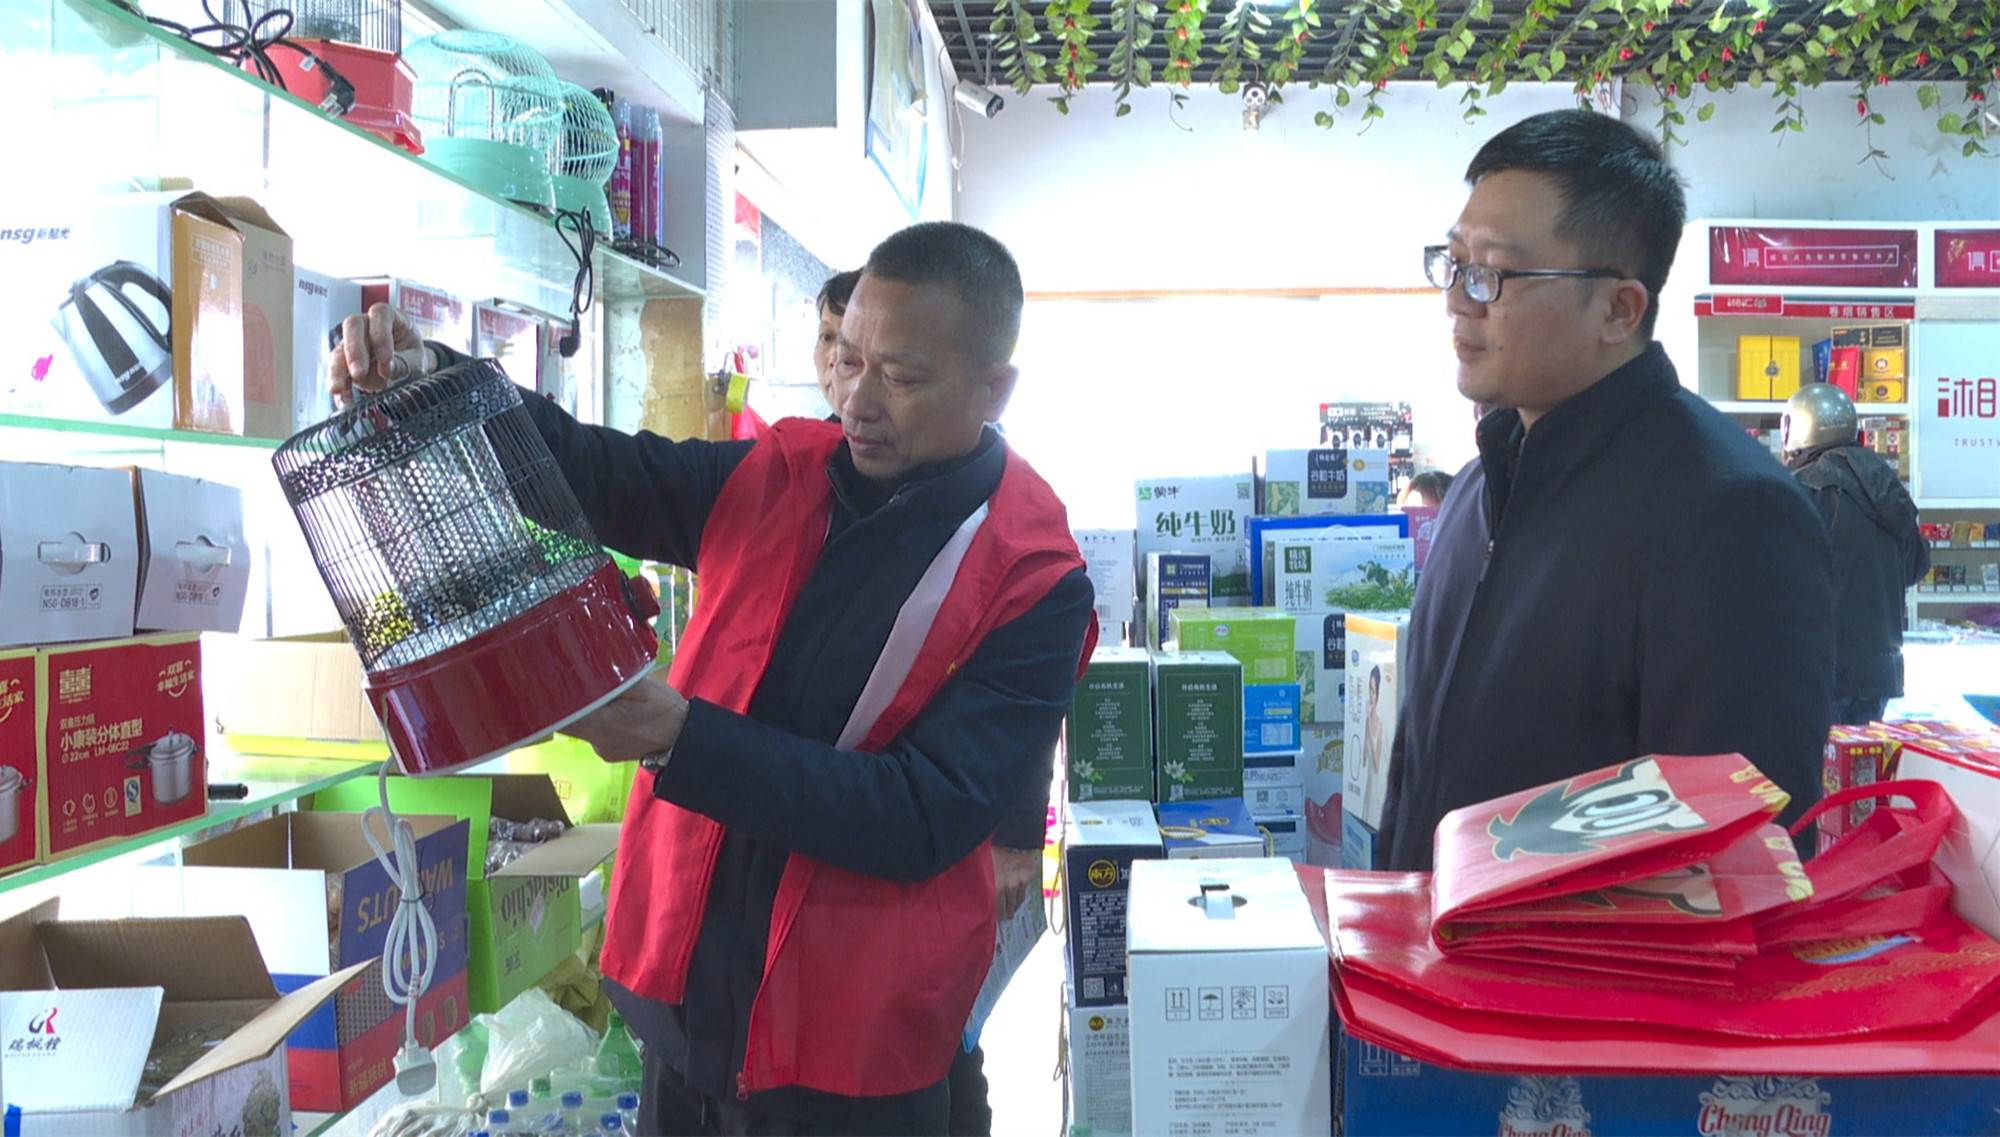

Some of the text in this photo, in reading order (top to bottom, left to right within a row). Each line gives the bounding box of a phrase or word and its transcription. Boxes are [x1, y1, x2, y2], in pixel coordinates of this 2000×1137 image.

[1829, 306, 1895, 318] 卷烟销售区
[1310, 469, 1346, 482] 谷粒牛奶
[1156, 509, 1236, 538] 纯牛奶
[1285, 579, 1312, 607] 纯牛奶
